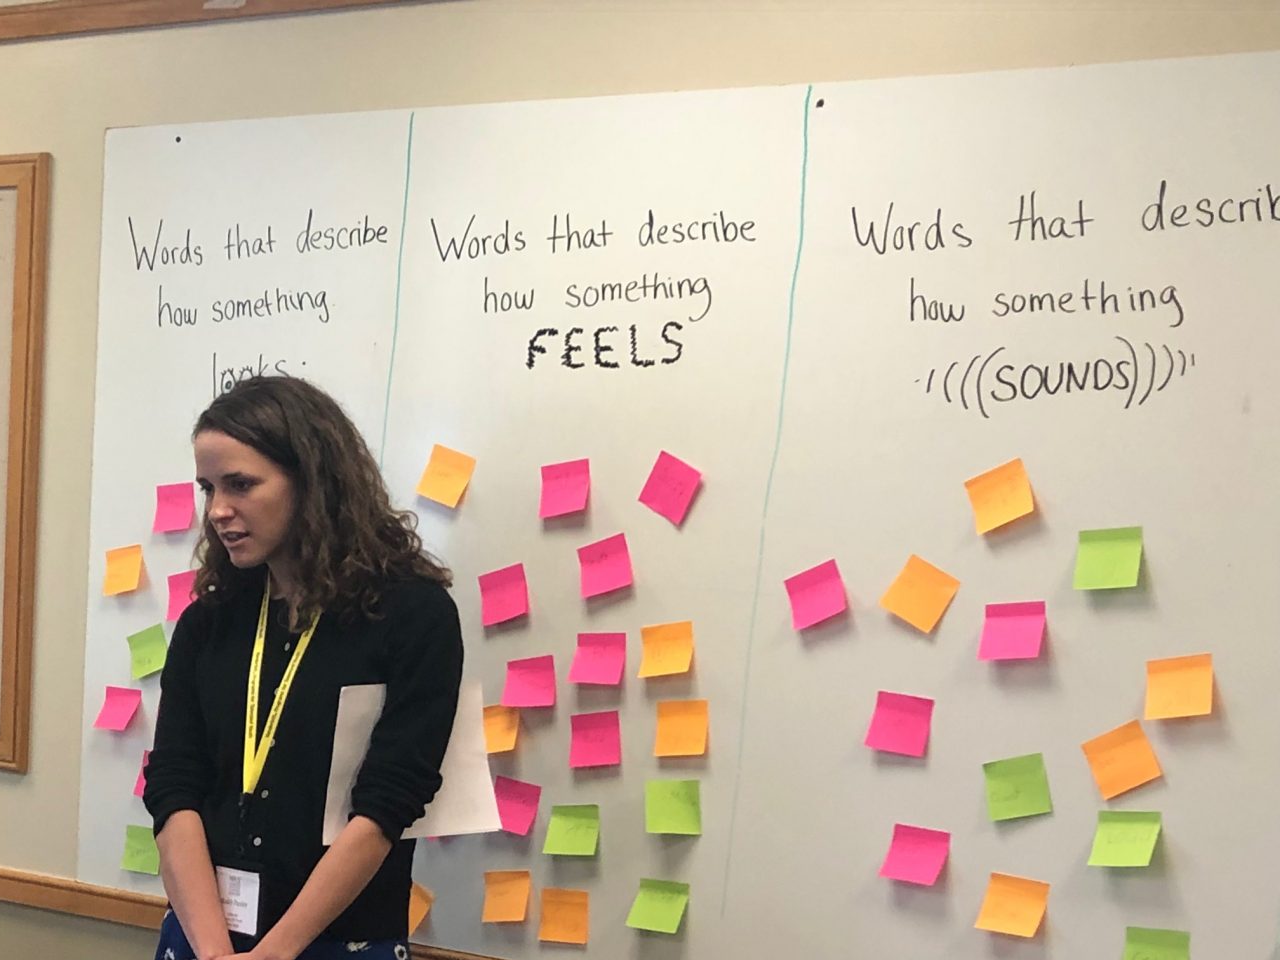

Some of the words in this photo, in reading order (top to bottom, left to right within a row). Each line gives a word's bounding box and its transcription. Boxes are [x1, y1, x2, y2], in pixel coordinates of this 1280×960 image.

[128, 216, 203, 271] Words
[224, 223, 277, 260] that
[296, 208, 388, 253] describe
[431, 214, 526, 262] Words
[546, 214, 614, 253] that
[638, 209, 757, 247] describe
[852, 202, 973, 255] Words
[1008, 191, 1095, 241] that
[158, 284, 198, 328] how
[212, 288, 330, 323] something
[483, 277, 534, 313] how
[566, 272, 712, 322] something
[910, 277, 965, 323] how
[992, 279, 1184, 328] something
[526, 321, 683, 369] FEELS
